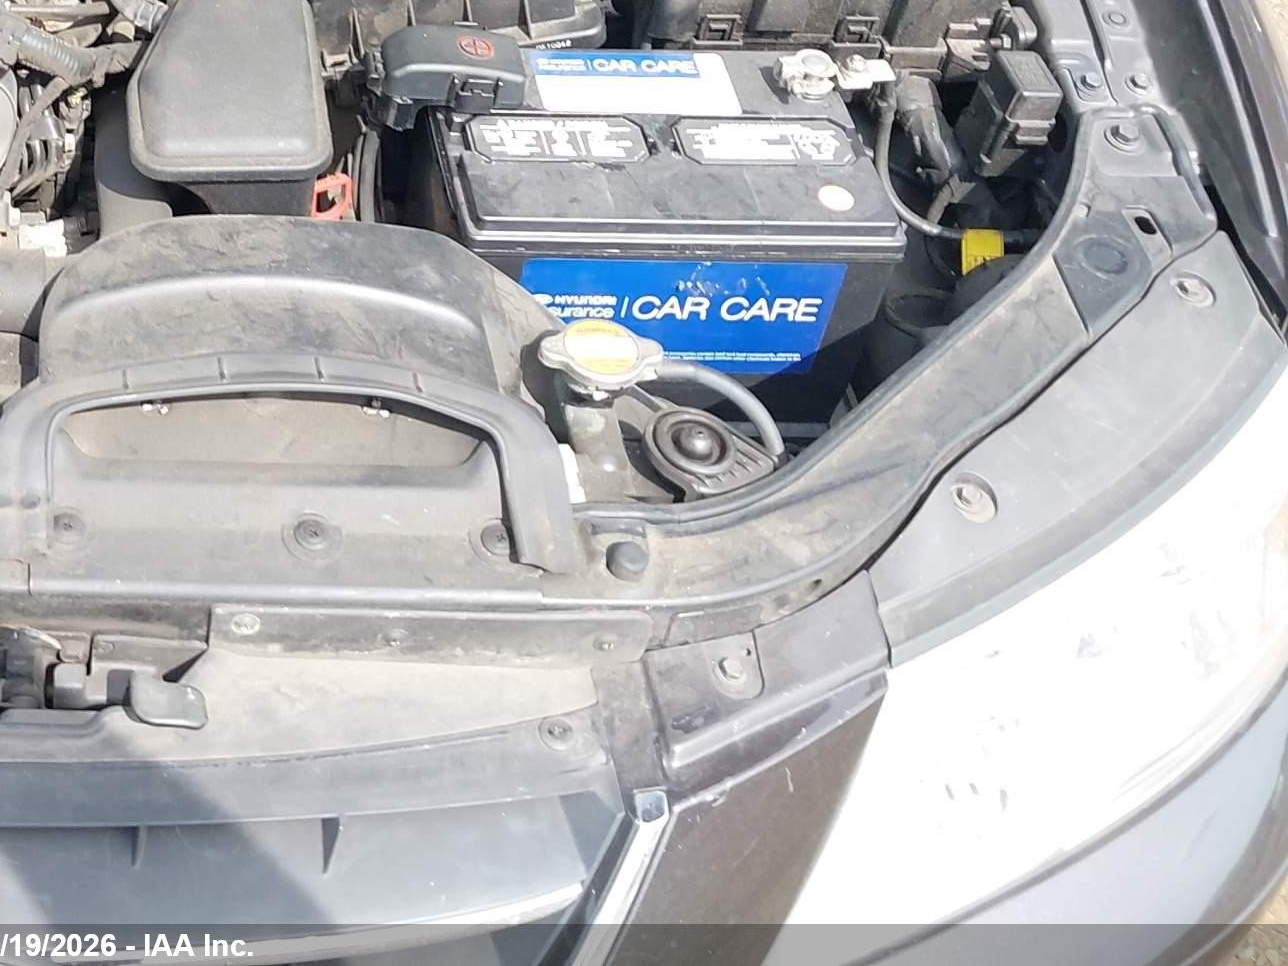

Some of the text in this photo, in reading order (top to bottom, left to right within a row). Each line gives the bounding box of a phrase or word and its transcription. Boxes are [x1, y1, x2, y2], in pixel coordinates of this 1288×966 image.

[592, 58, 638, 73] CAR
[641, 58, 698, 75] CARE
[631, 295, 823, 322] CAR CARE
